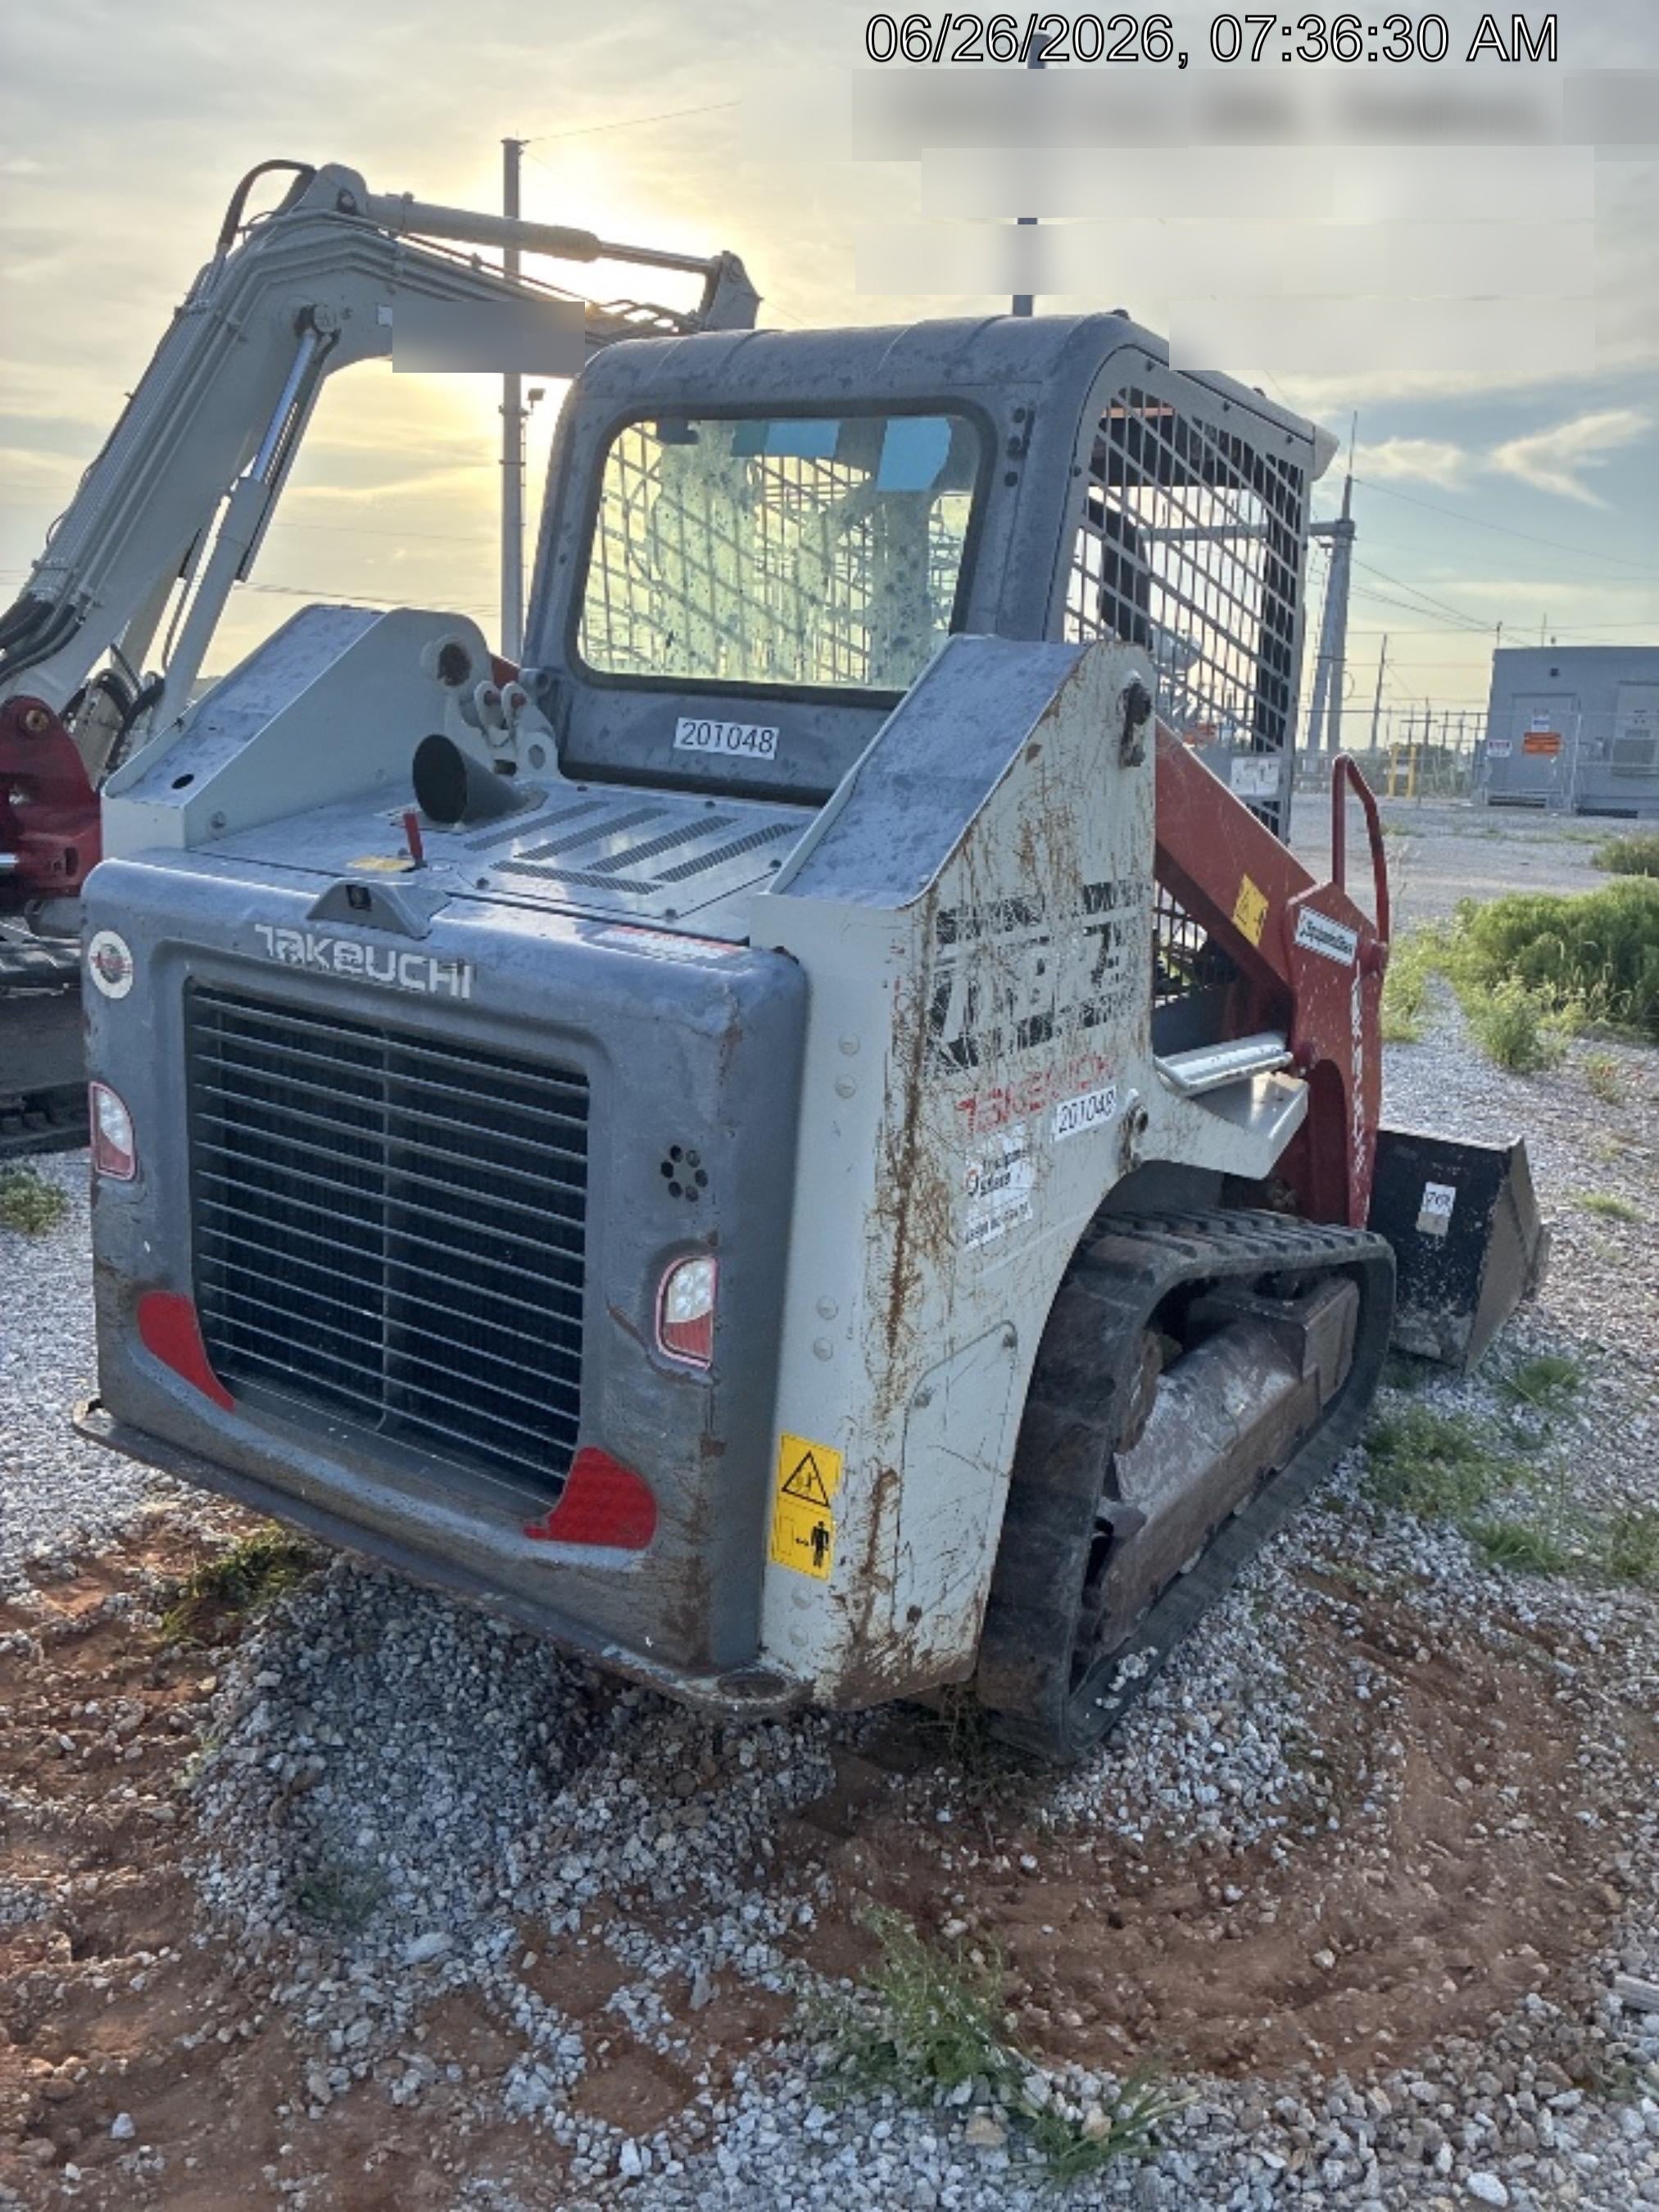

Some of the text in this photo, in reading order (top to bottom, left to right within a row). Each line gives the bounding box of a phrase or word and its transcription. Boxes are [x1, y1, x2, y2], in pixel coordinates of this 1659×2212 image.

[680, 722, 774, 754] 201048
[254, 923, 471, 999] TAKEUCHI
[1058, 1088, 1115, 1134] 201048
